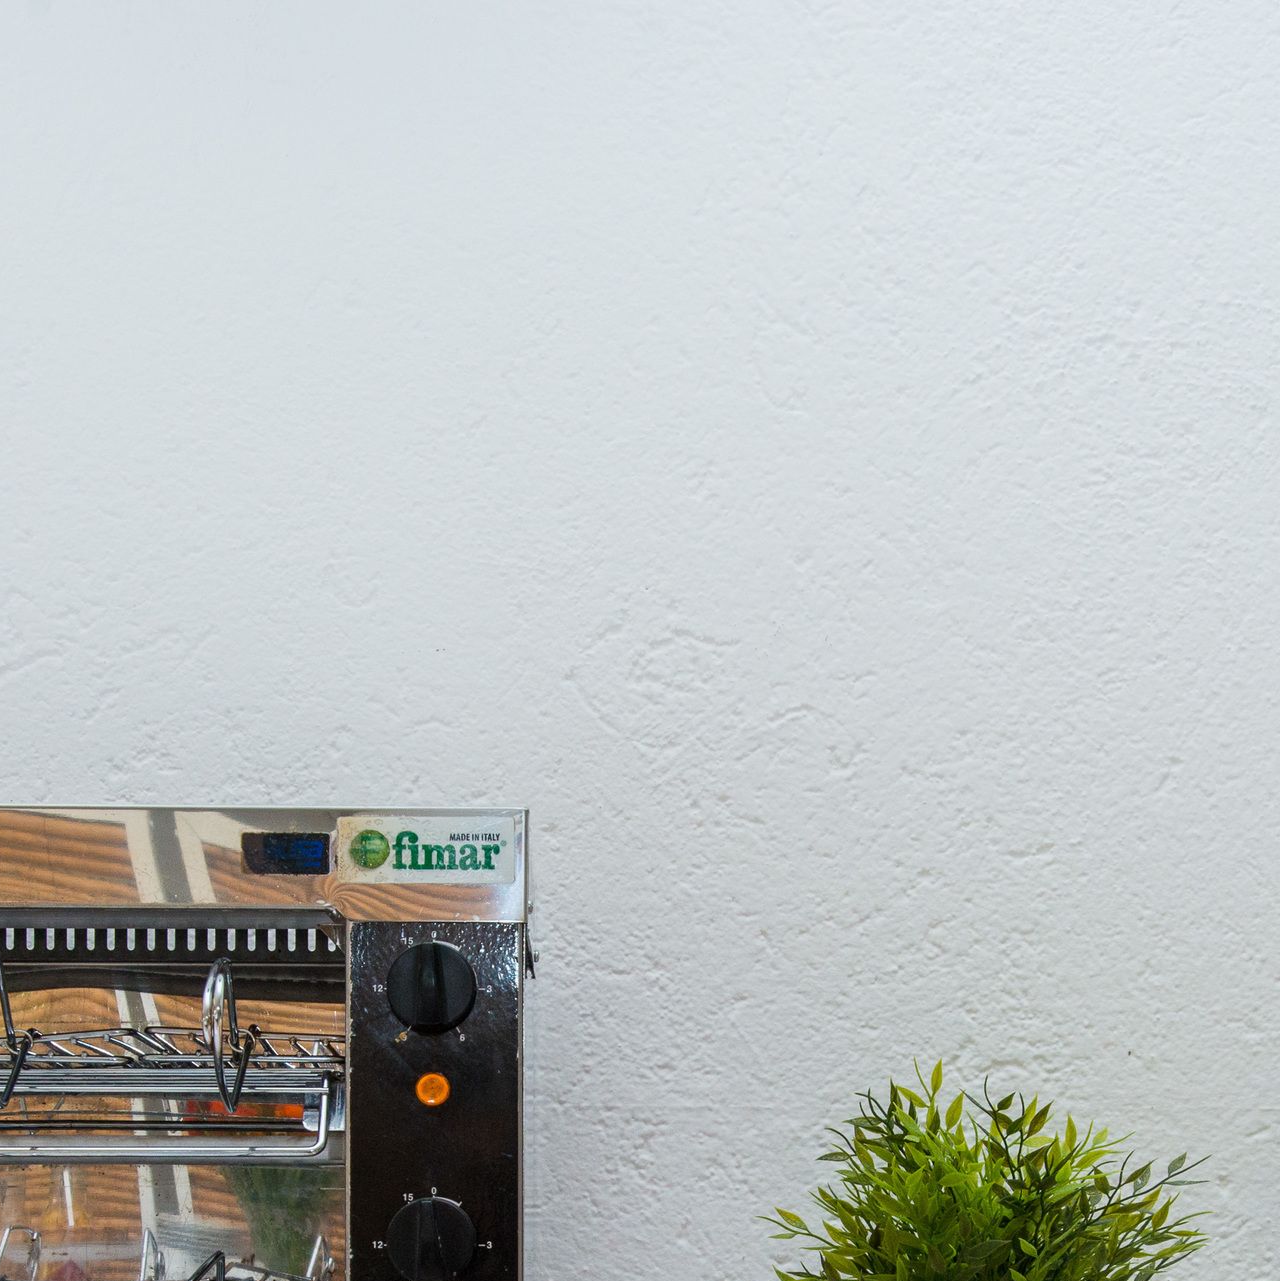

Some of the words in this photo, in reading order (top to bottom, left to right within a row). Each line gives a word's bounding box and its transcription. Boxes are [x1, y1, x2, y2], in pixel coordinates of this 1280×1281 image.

[449, 833, 470, 841] MADE
[471, 833, 480, 841] IN
[481, 833, 500, 841] ITALY
[392, 830, 500, 870] fimar
[431, 930, 437, 938] 0
[372, 984, 383, 992] 12
[486, 984, 493, 993] 3
[459, 1033, 466, 1041] 6
[431, 1186, 437, 1195] 0
[402, 1193, 414, 1201] 15
[372, 1241, 383, 1249] 12
[486, 1241, 493, 1249] 3
